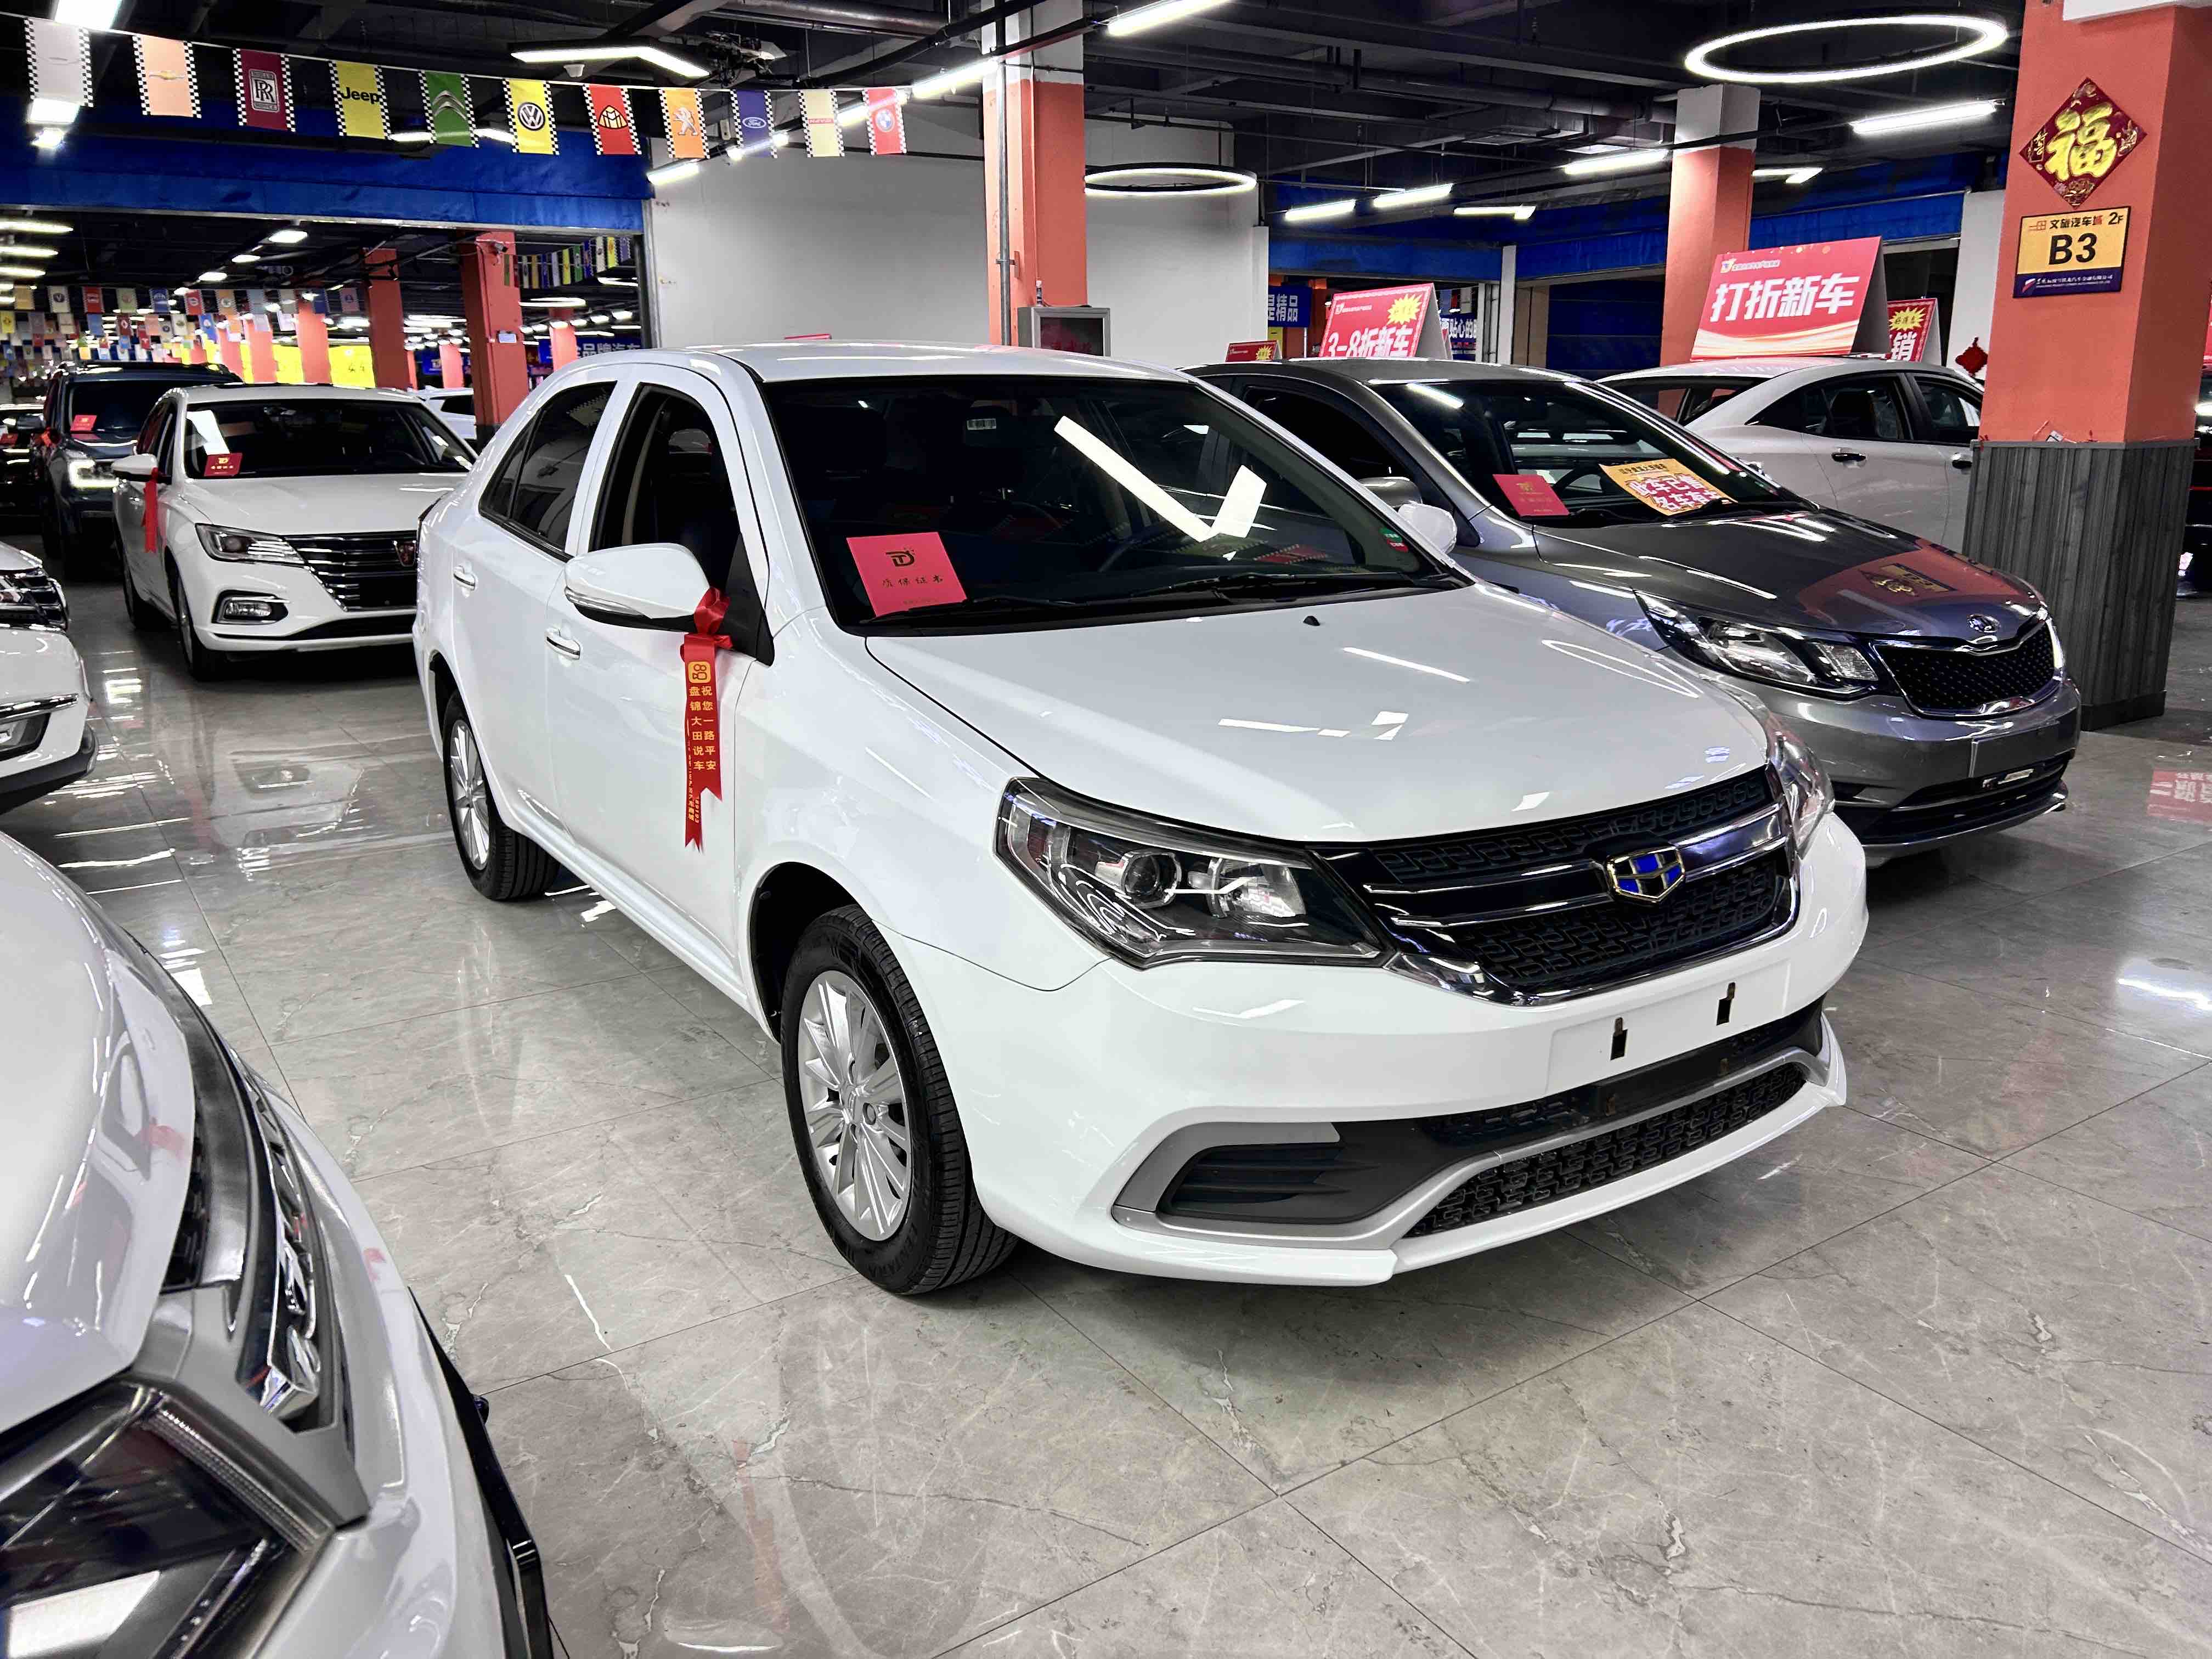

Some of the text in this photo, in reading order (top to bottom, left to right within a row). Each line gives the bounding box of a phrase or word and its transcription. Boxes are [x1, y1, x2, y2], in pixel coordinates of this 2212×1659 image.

[340, 87, 380, 104] Jeep
[2045, 102, 2118, 182] 福
[2108, 212, 2123, 225] 2F
[2049, 233, 2097, 265] B3
[1709, 273, 1860, 323] 打折新车
[1628, 474, 1705, 496] 此车已售
[689, 686, 705, 771] 盘锦大田说车
[701, 686, 716, 770] 祝您一路平安
